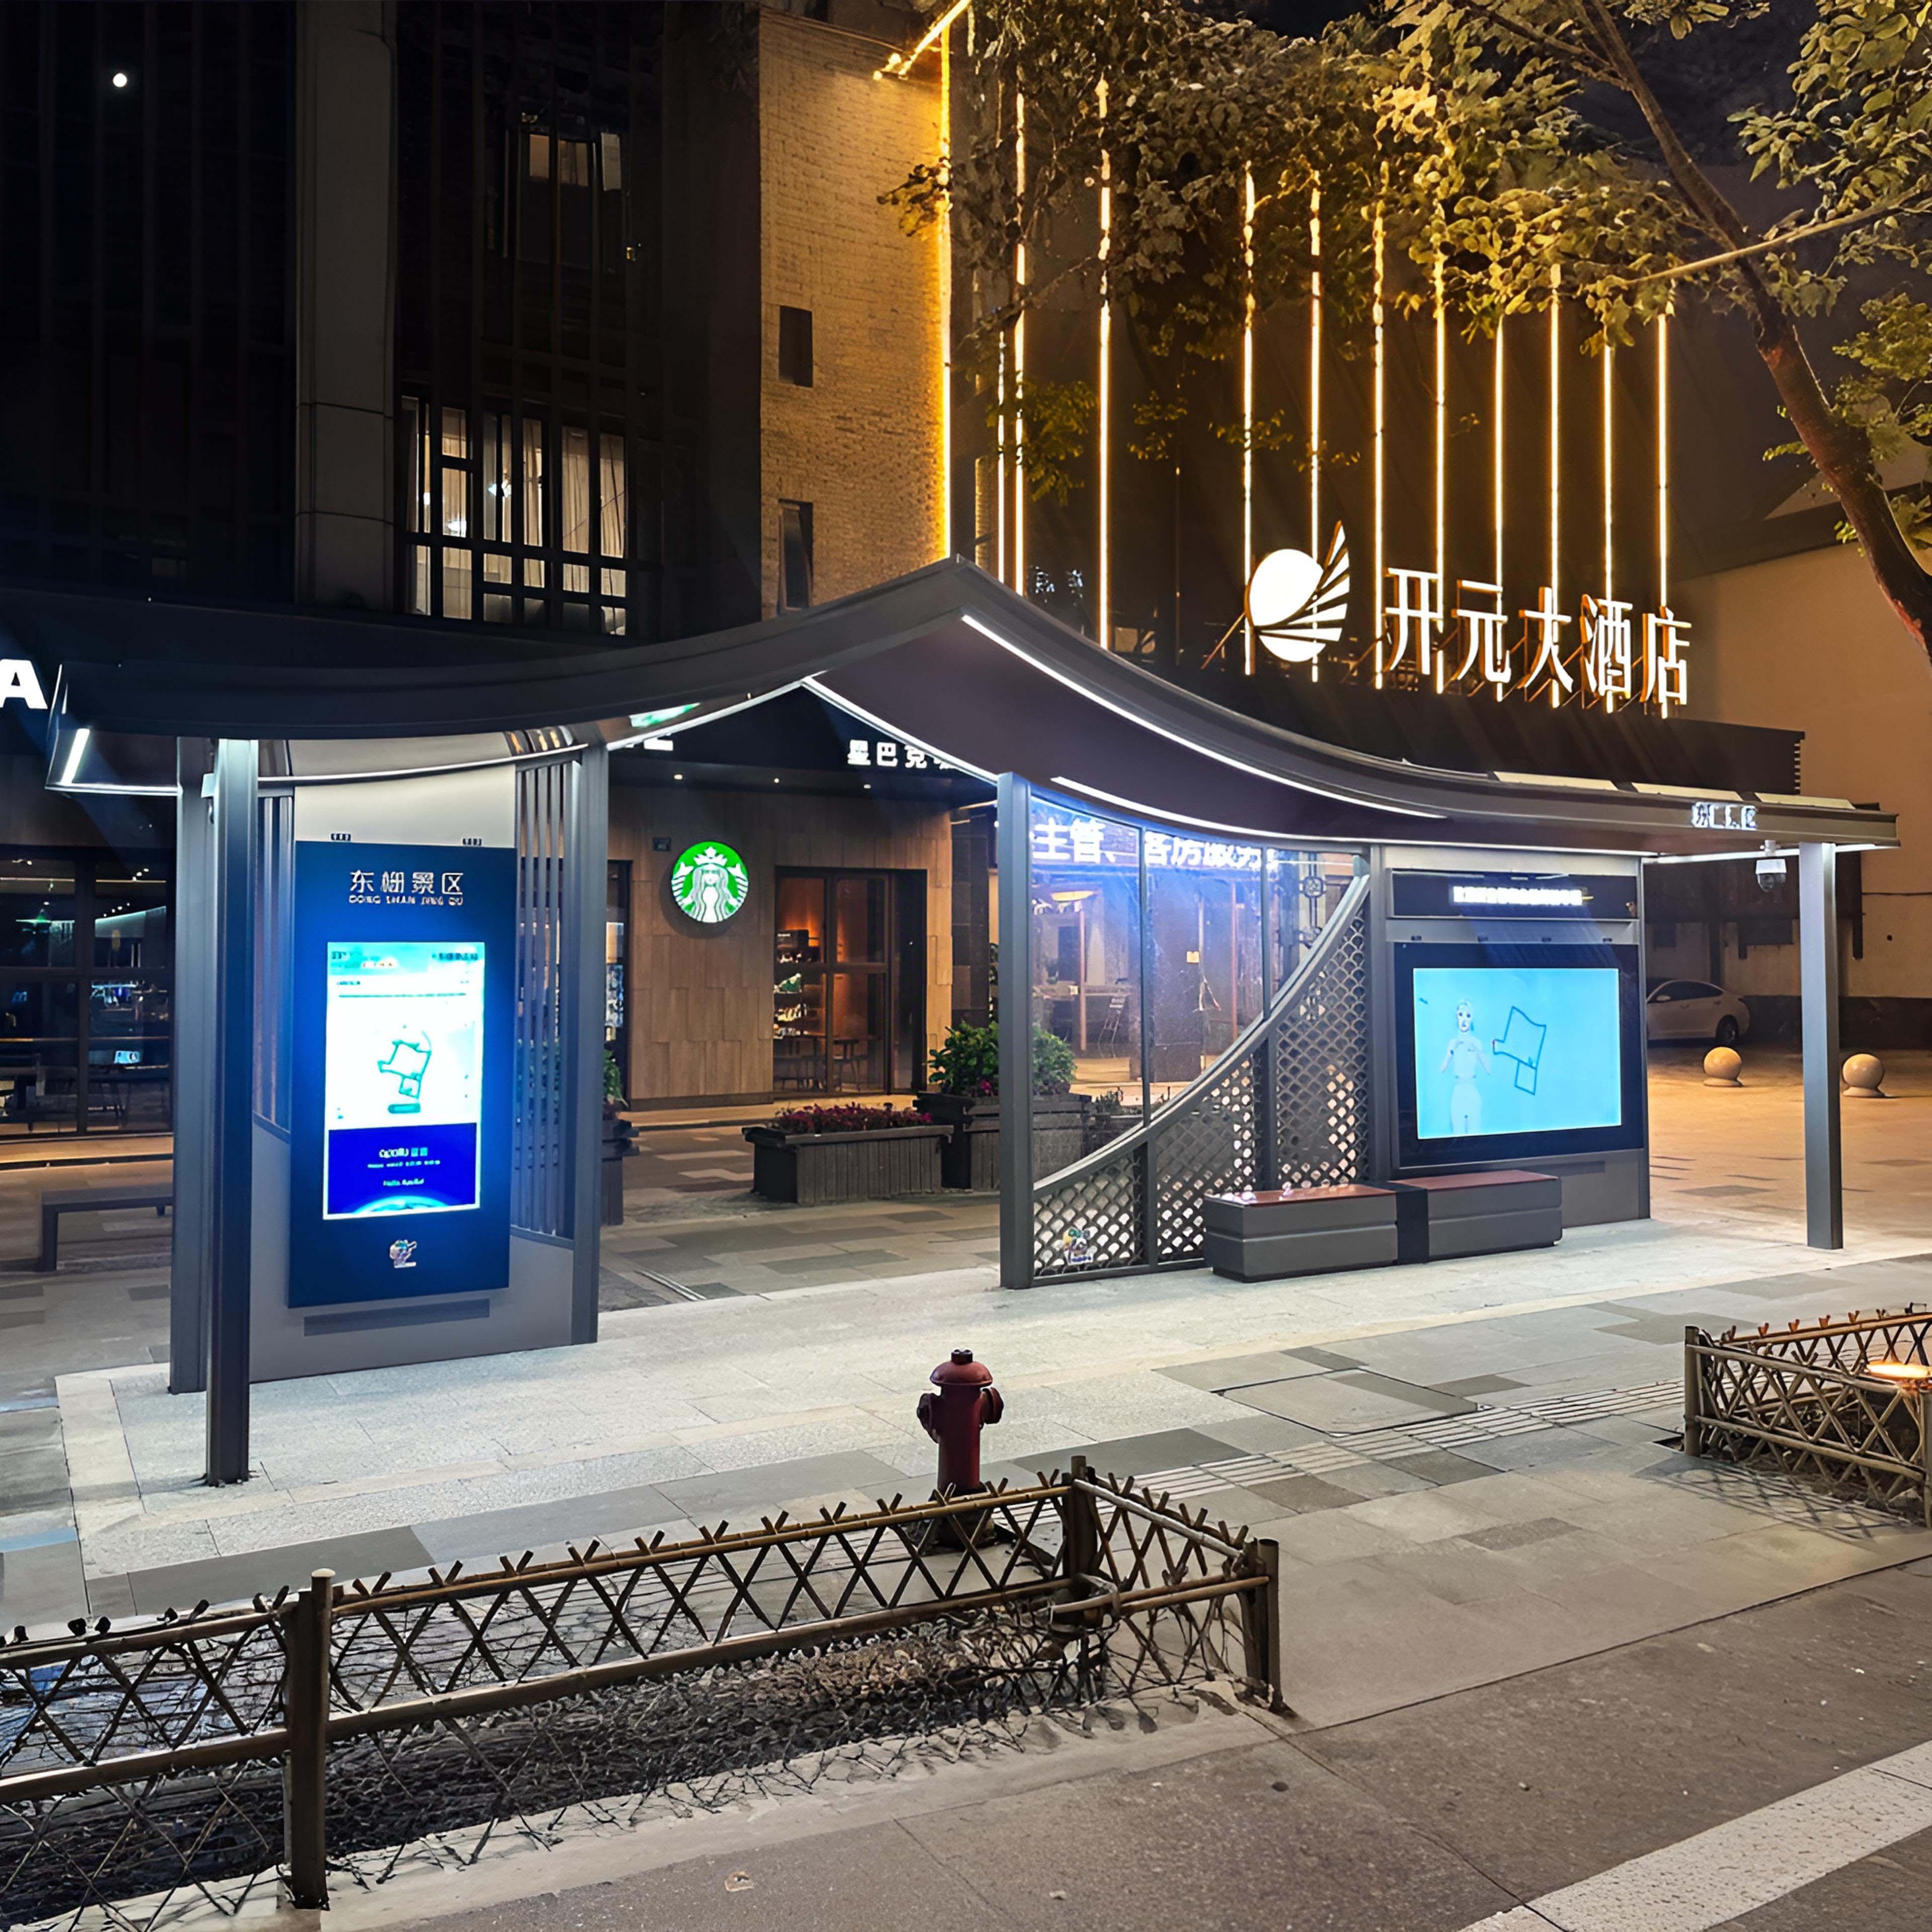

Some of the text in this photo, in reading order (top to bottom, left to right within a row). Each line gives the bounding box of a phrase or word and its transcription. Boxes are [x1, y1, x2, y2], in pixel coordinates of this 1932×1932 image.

[1384, 568, 1692, 705] 开元大酒店
[847, 739, 958, 770] 星巴克
